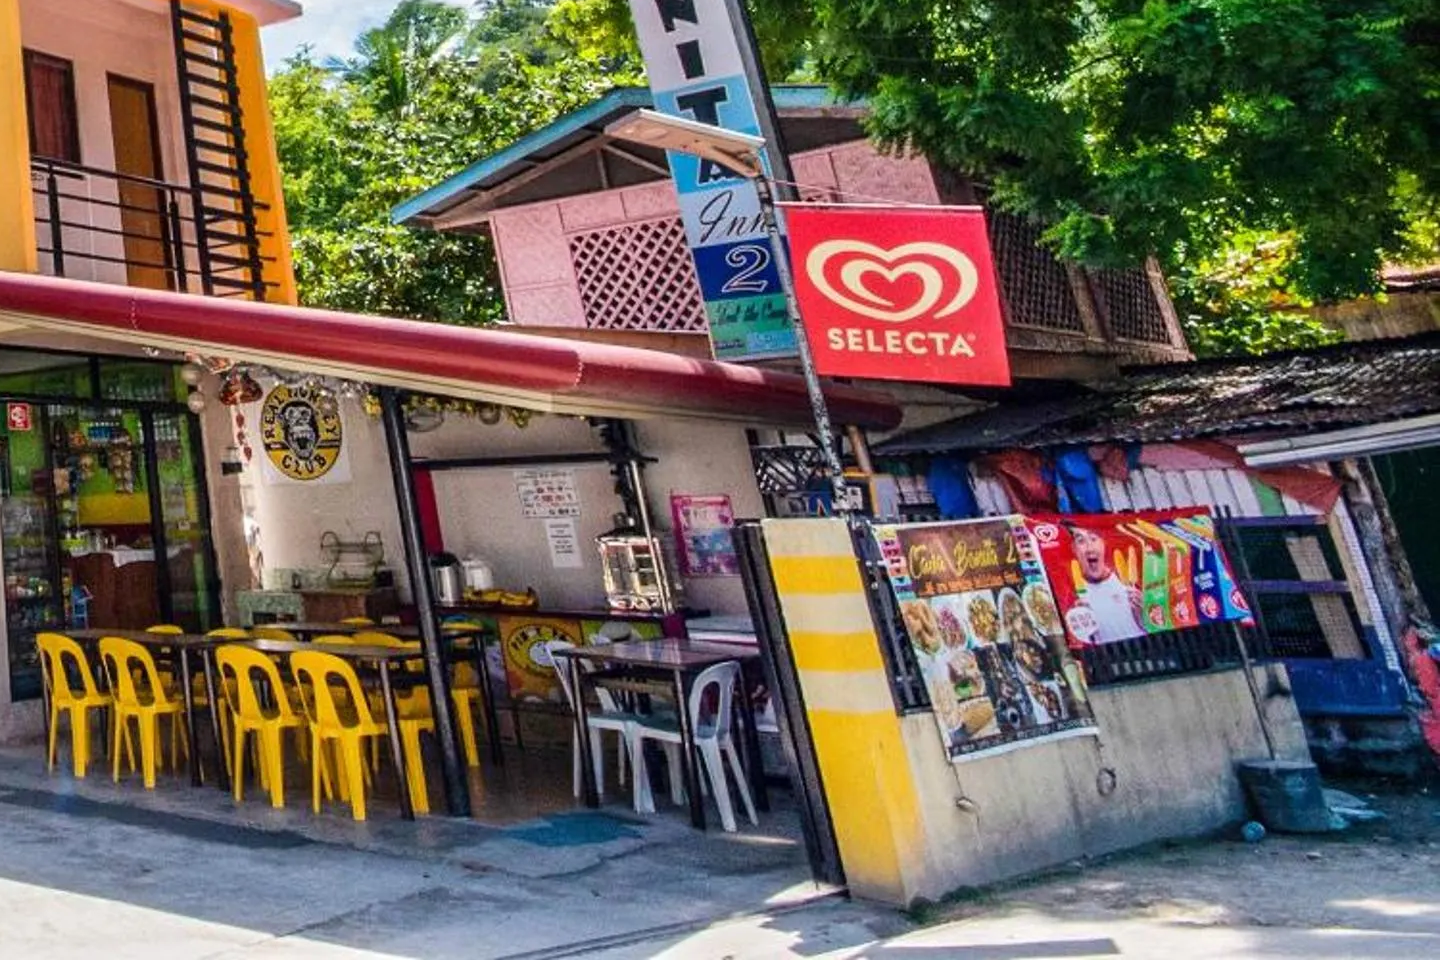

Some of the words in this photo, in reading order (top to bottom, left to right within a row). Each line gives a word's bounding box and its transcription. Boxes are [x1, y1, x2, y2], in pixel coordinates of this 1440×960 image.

[722, 245, 770, 292] 2
[827, 327, 975, 358] SELECTA
[264, 391, 285, 439] REAL
[282, 454, 327, 475] CLUB
